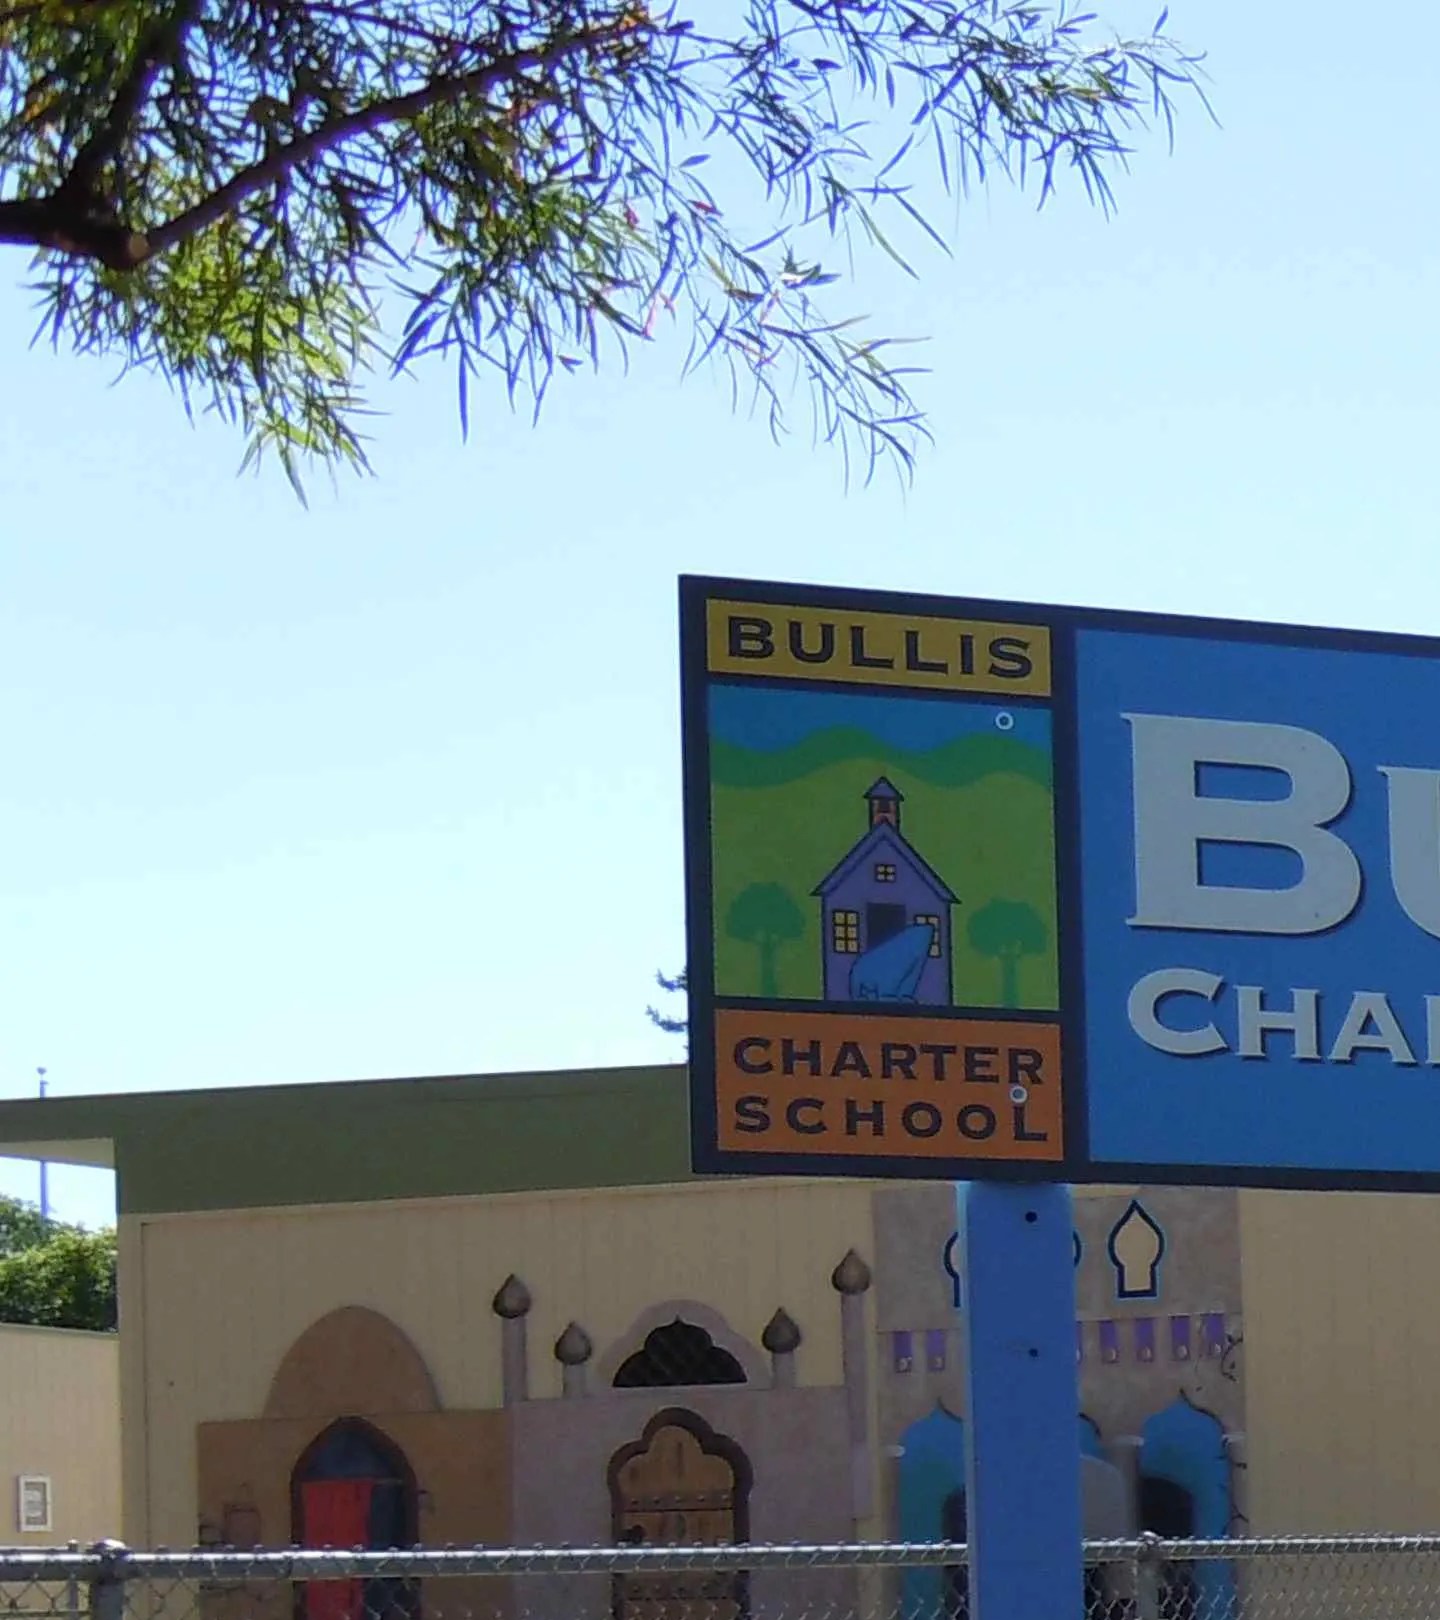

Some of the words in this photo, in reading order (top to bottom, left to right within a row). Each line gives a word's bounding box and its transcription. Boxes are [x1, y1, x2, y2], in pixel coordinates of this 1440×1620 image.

[727, 615, 1033, 678] BULLIS
[733, 1036, 1043, 1085] CHARTER
[733, 1096, 1047, 1142] SCHOOL
